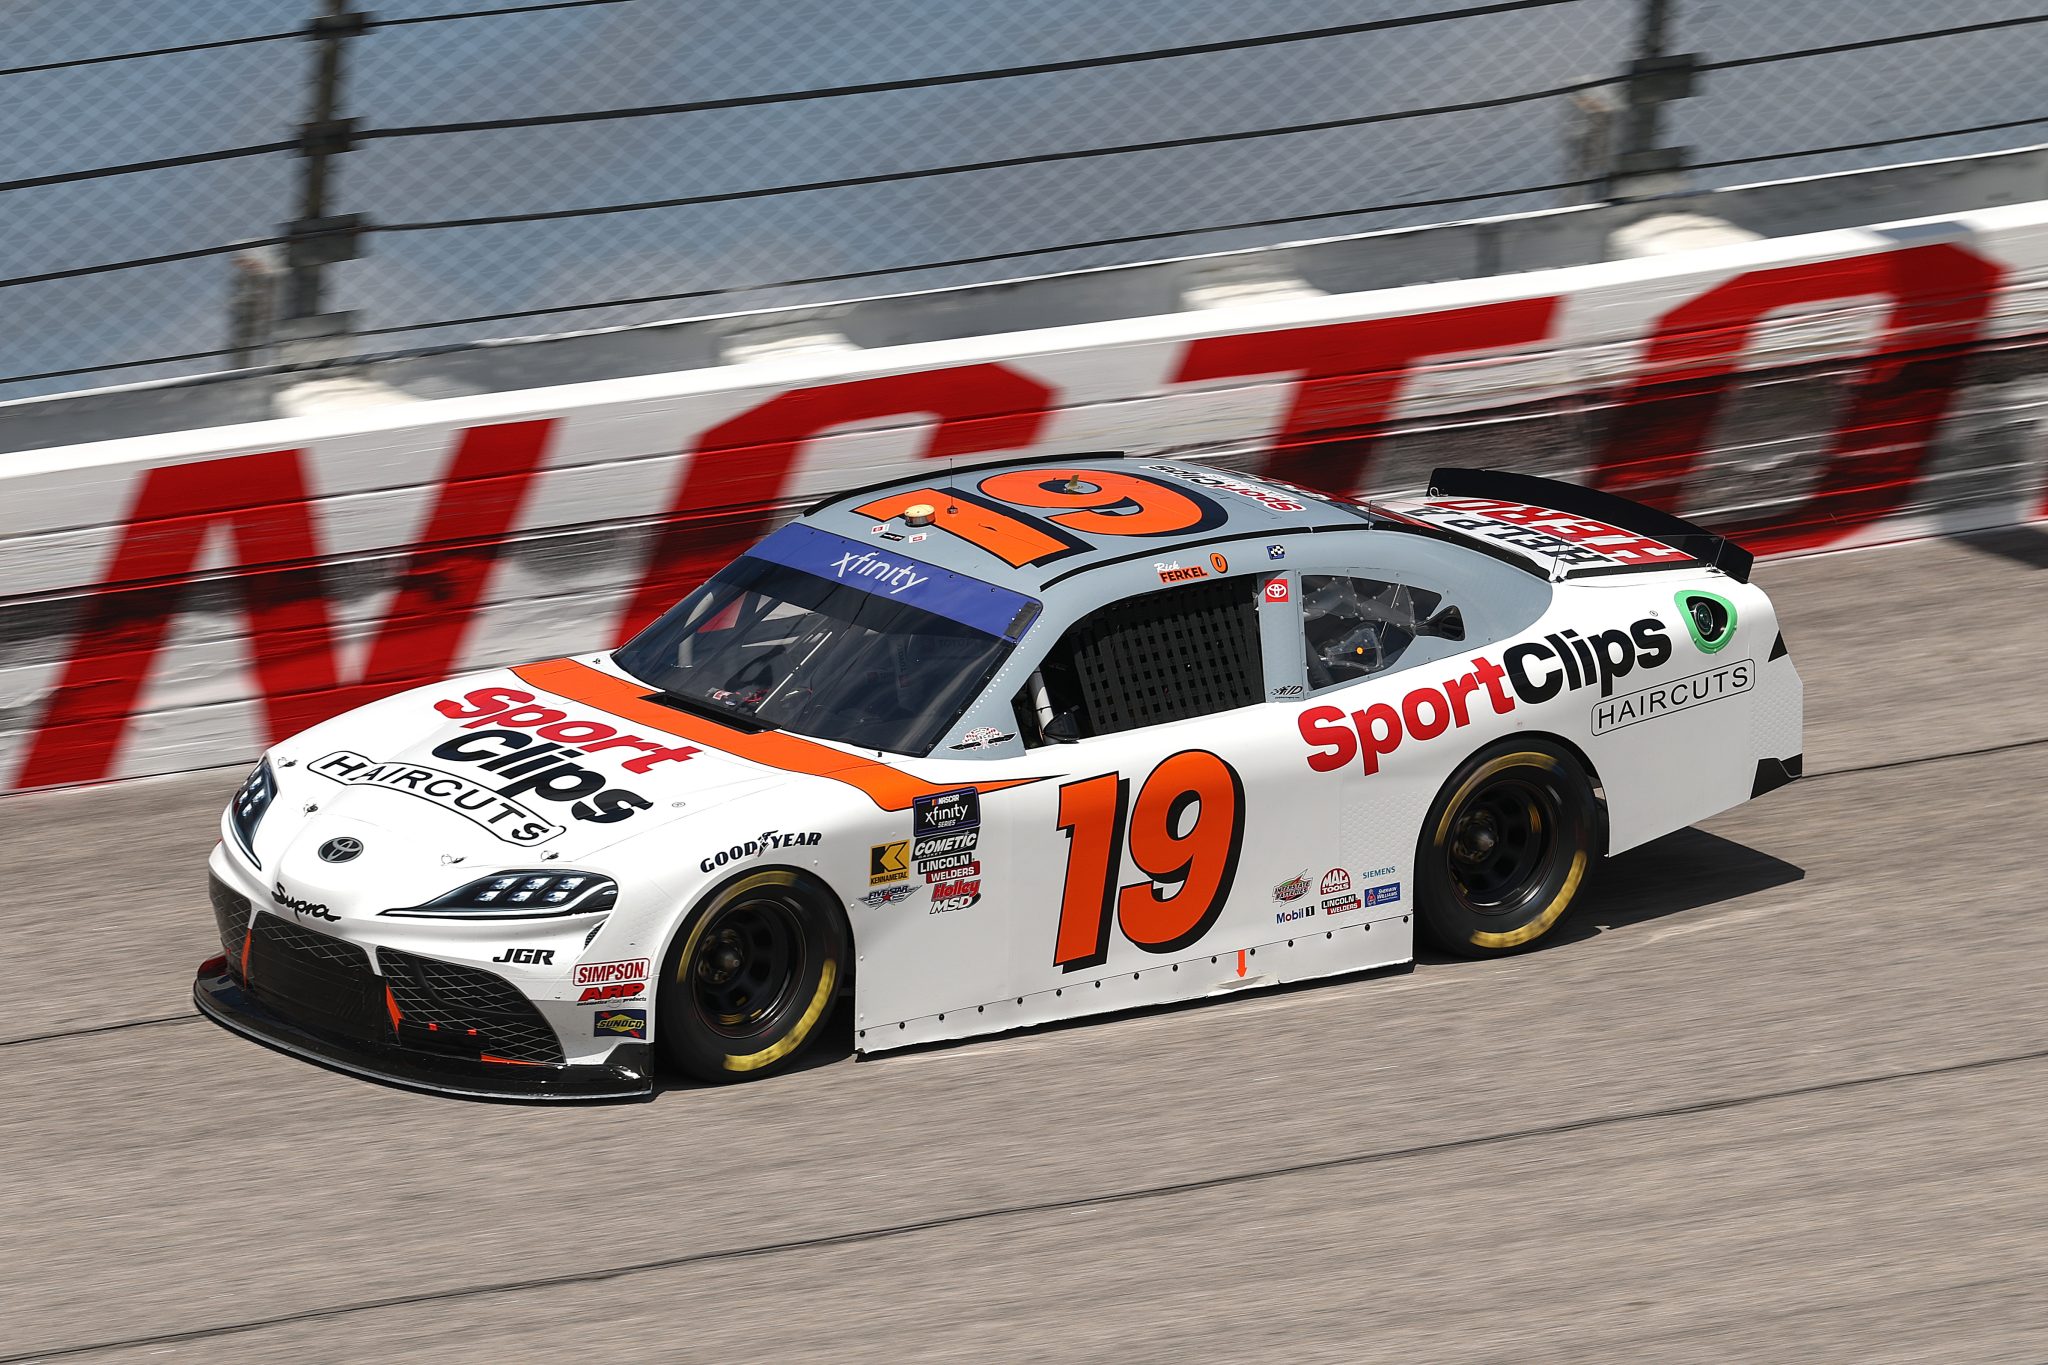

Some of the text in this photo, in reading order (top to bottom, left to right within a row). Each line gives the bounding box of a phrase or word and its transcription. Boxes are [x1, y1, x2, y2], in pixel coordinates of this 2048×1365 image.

[849, 468, 1228, 569] 19
[1423, 499, 1698, 565] HERO
[1443, 519, 1616, 565] HELP
[830, 551, 929, 595] xfinity
[1153, 560, 1181, 573] Rick
[1159, 566, 1208, 583] FERKEL
[1598, 666, 1749, 727] HAIRCUTS
[433, 686, 703, 775] Sport
[431, 729, 654, 824] Clips
[320, 755, 550, 841] HAIRCUTS
[938, 794, 960, 805] NASCAR
[925, 803, 968, 826] xfinity
[937, 819, 956, 828] SERIES
[914, 833, 977, 856] COMETIC
[920, 854, 970, 873] LINCOLN
[1053, 748, 1246, 975] 19
[870, 871, 908, 885] KENNAMETAL
[930, 866, 975, 882] WELDERS
[1322, 869, 1349, 888] MAC
[1362, 865, 1396, 879] SIEMENS
[931, 879, 981, 902] Holley
[1321, 882, 1350, 894] TOOLS
[271, 881, 342, 923] Supra
[930, 894, 980, 914] MSD
[1322, 895, 1355, 909] LINCOLN
[1330, 902, 1358, 914] WELDERS
[1276, 906, 1315, 924] Mobil 1
[492, 948, 556, 966] JGR
[578, 961, 645, 984] SIMPSON
[577, 982, 645, 1002] ARP
[598, 1019, 644, 1029] SUNOCO
